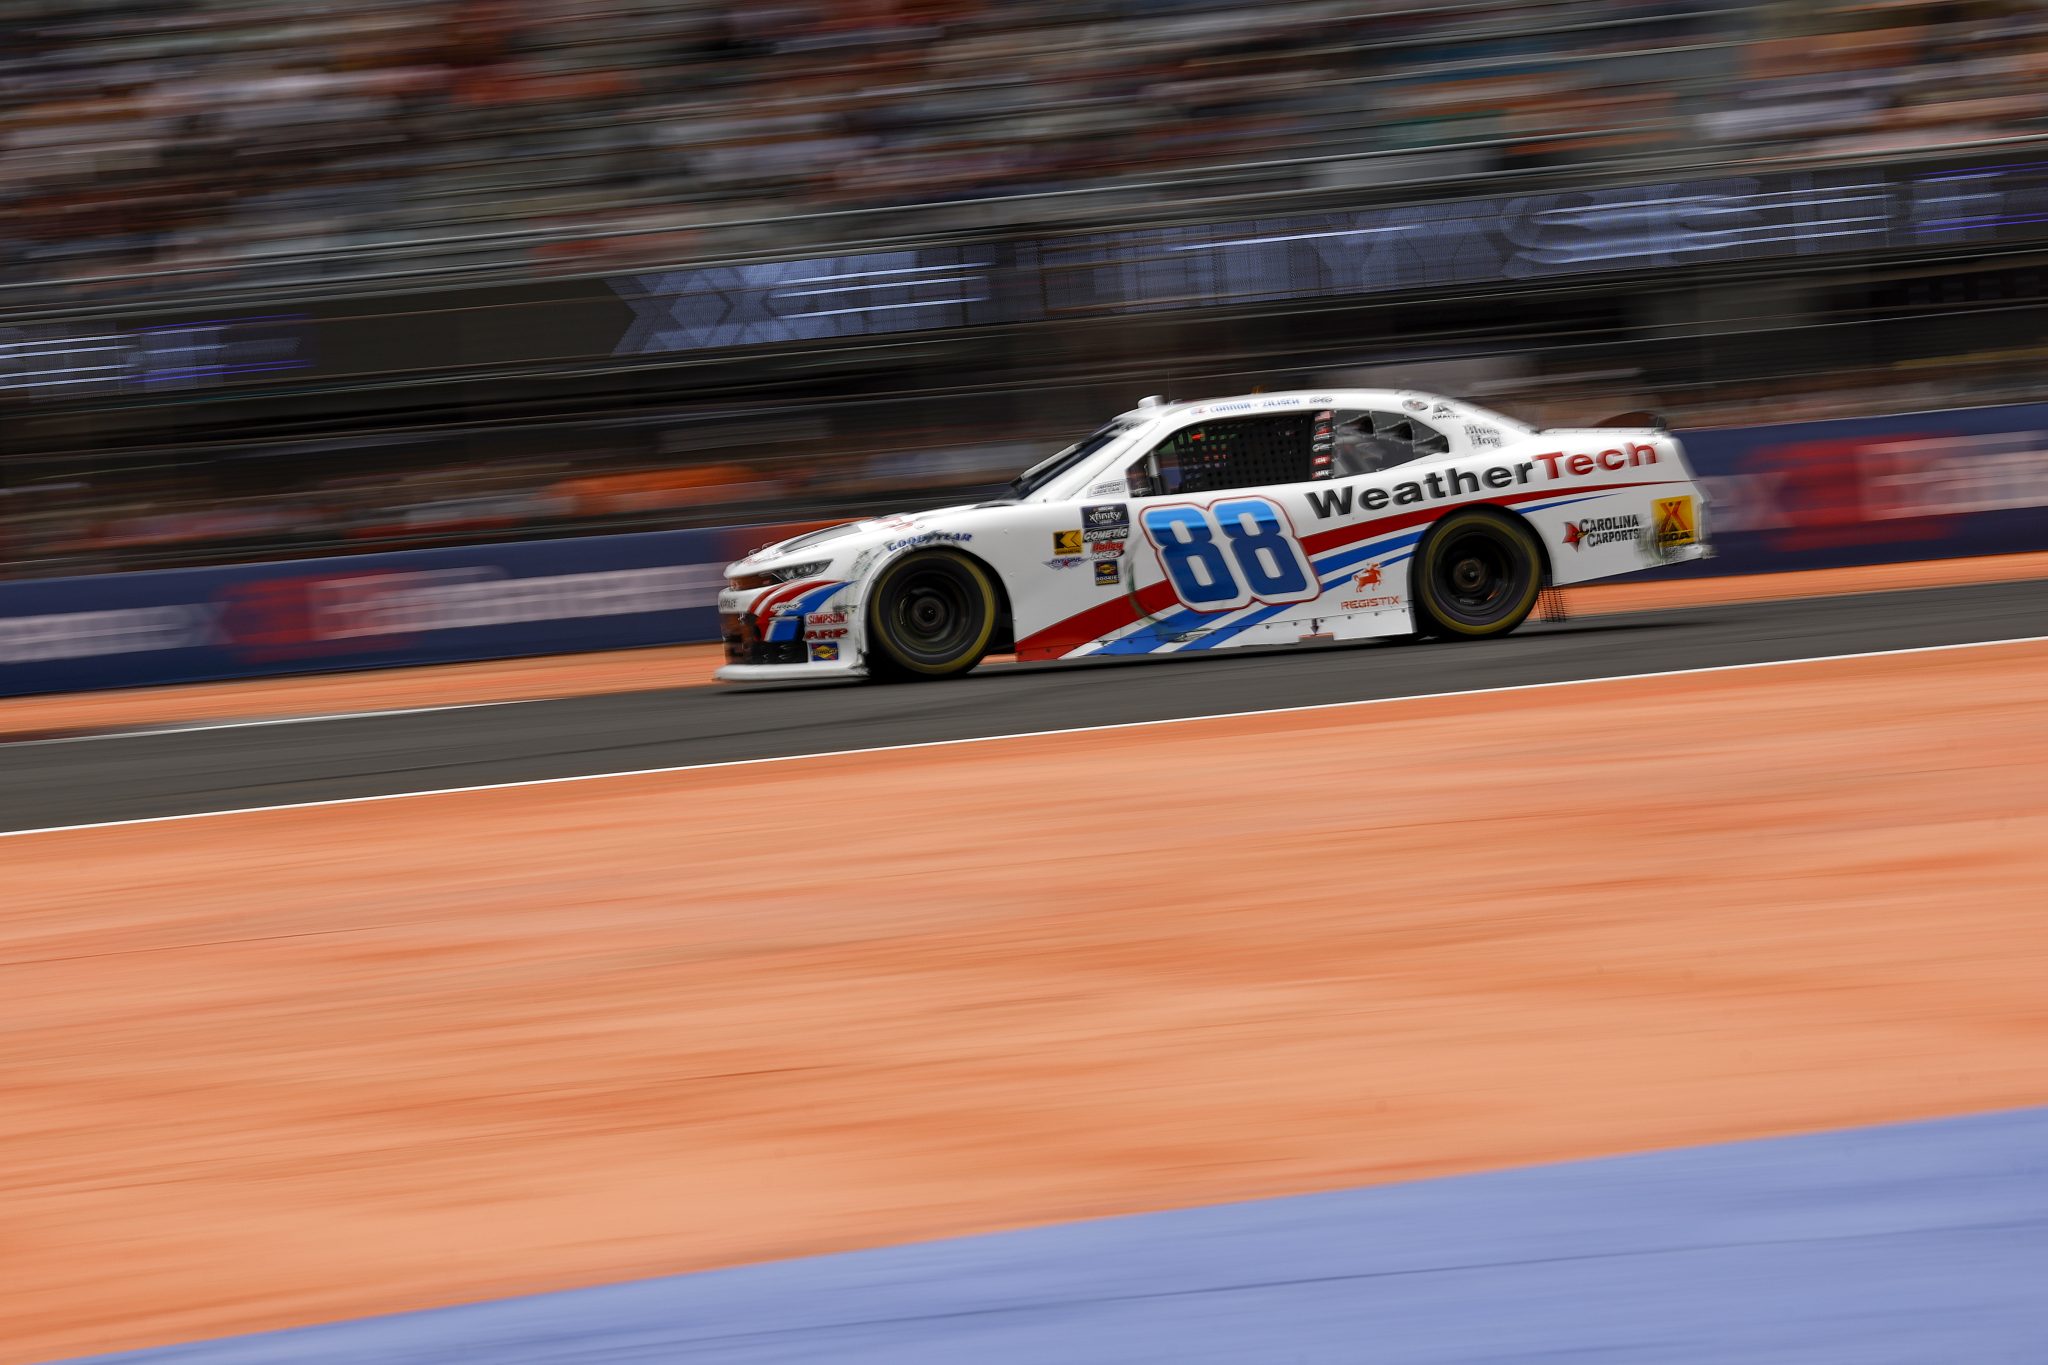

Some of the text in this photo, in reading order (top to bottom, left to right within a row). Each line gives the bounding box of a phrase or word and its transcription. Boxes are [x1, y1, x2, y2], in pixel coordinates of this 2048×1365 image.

[1304, 442, 1657, 519] WeatherTech
[1089, 511, 1121, 524] xfinity
[1578, 514, 1640, 533] CAROLINA
[1084, 529, 1128, 541] COMETIC
[1586, 528, 1640, 548] CARPORTS
[1144, 498, 1309, 605] 88
[1341, 595, 1400, 610] REGISTIX
[807, 613, 846, 625] SIMPSON
[804, 628, 848, 640] ARP
